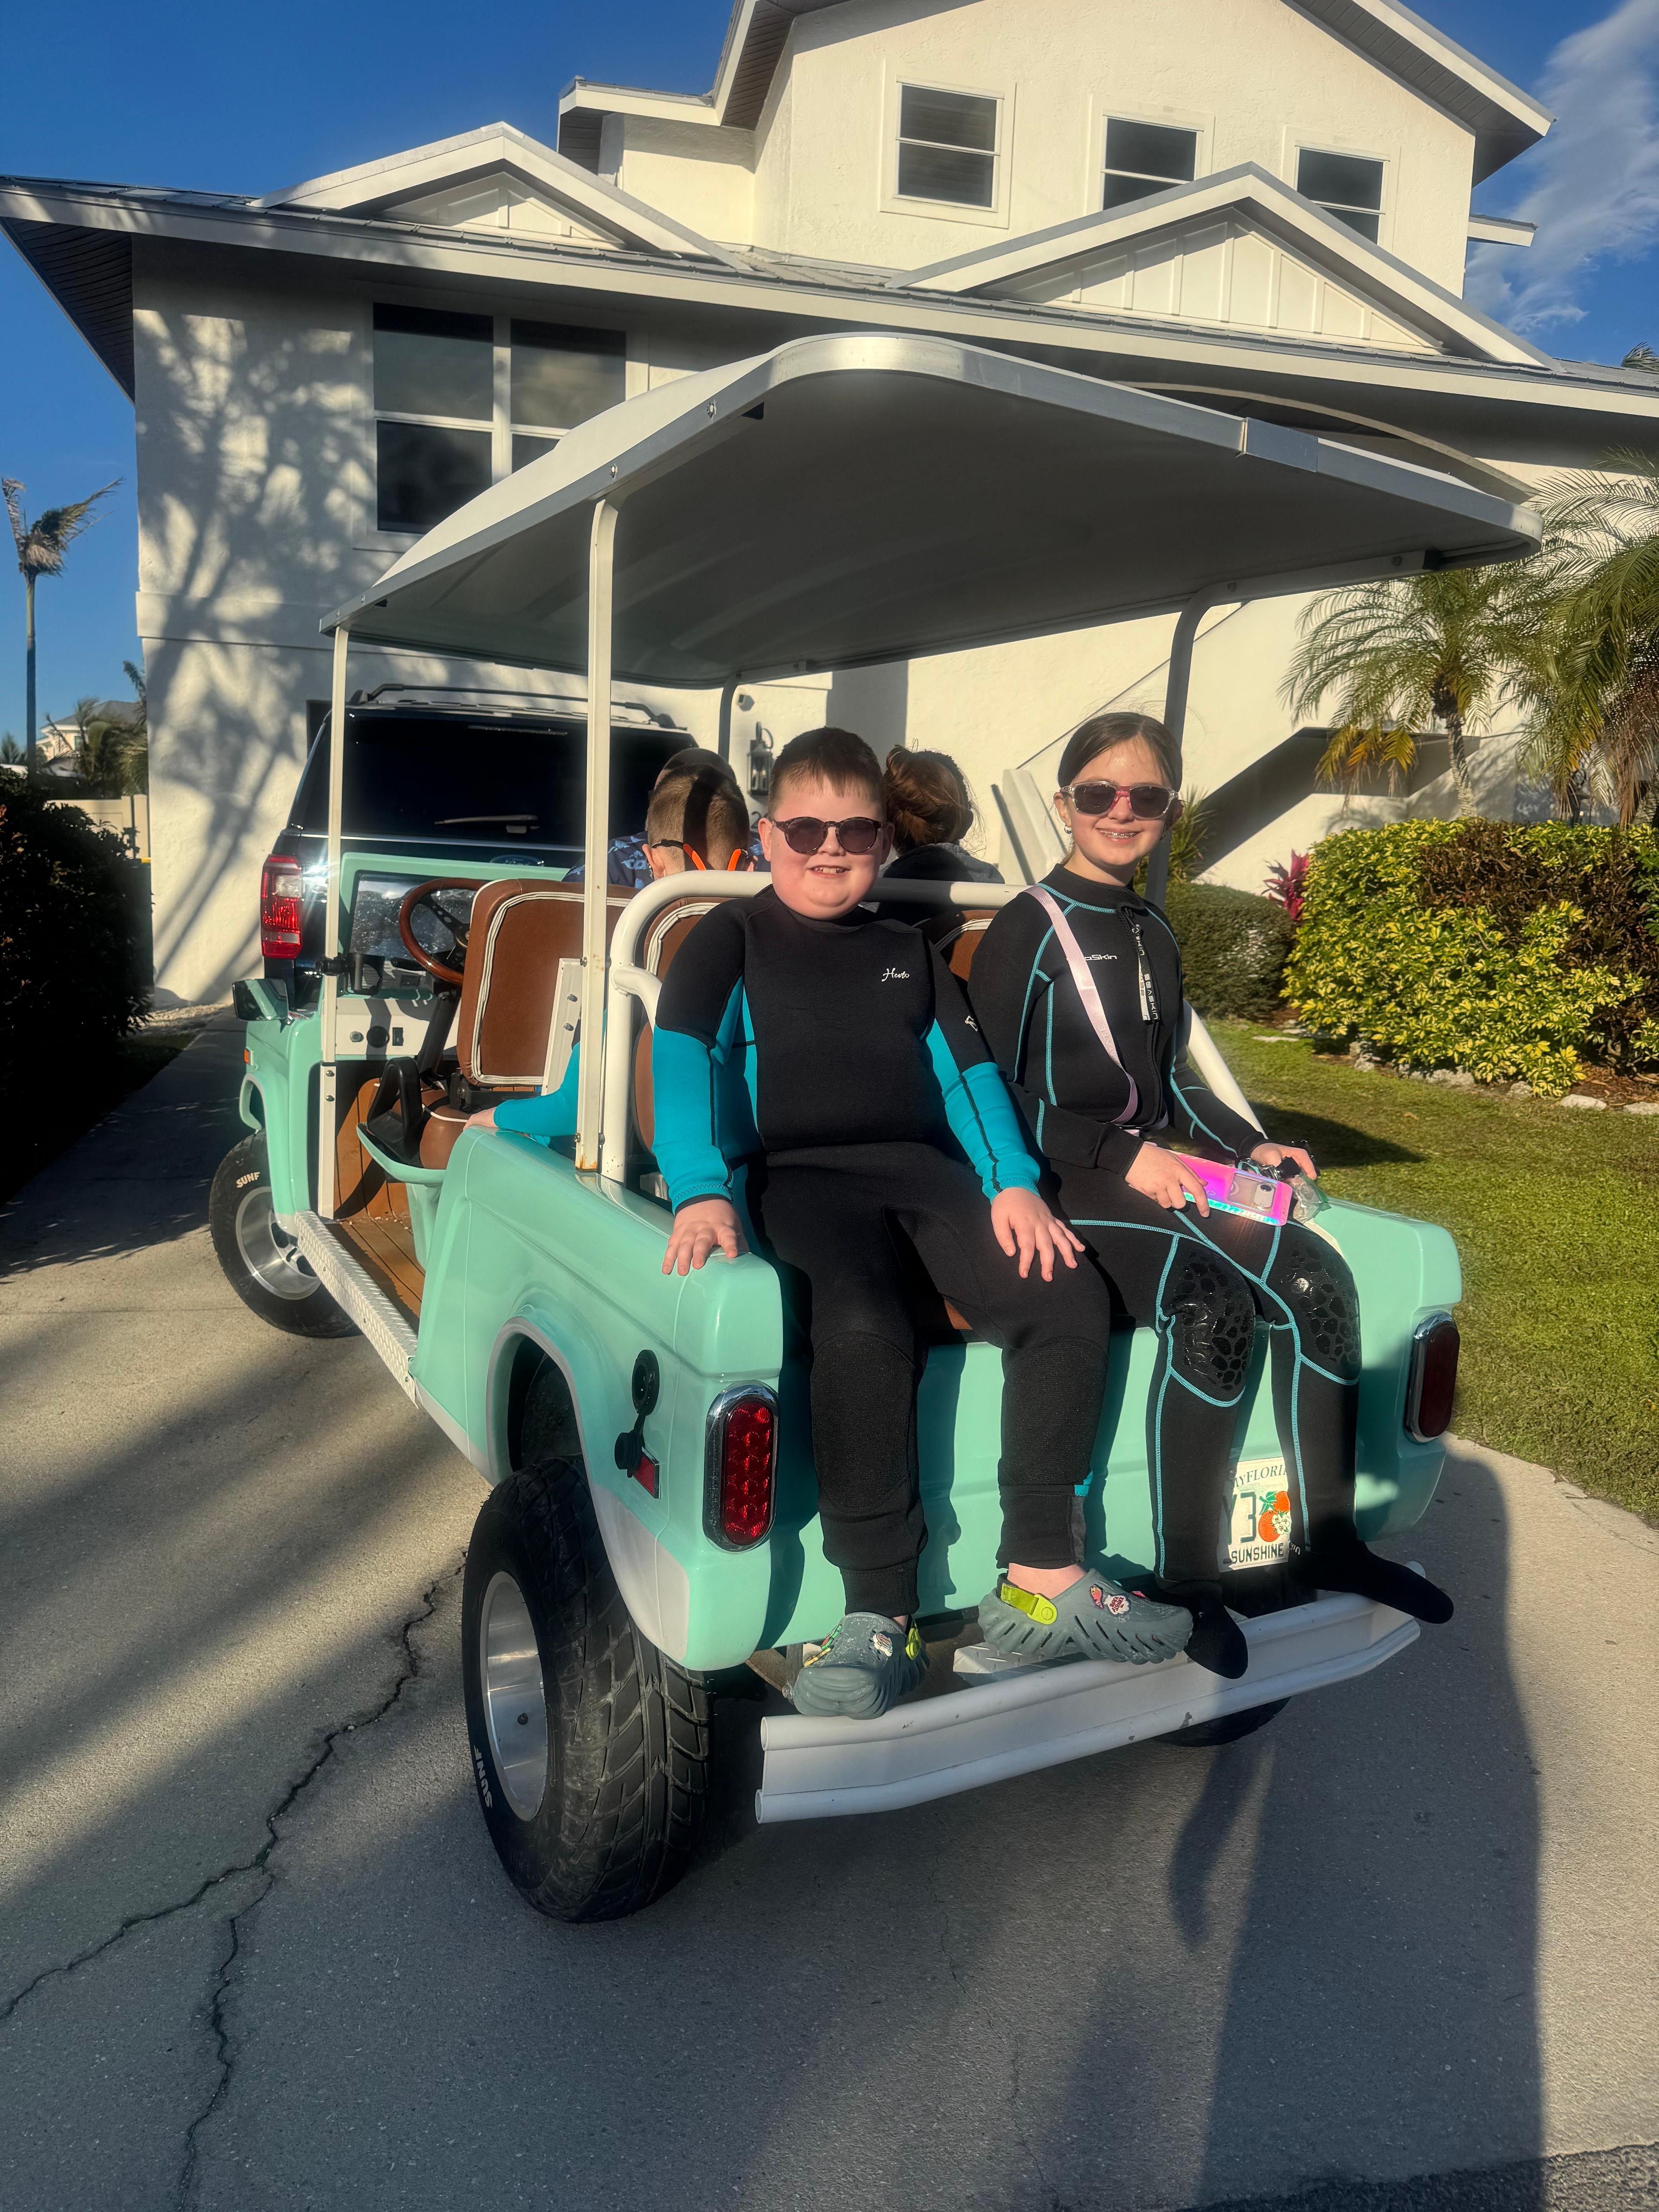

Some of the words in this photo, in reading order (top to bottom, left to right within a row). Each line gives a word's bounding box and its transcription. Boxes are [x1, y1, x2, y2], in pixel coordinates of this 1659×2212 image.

[236, 1172, 260, 1188] SUNF
[1231, 1542, 1283, 1564] SUNSHINE
[474, 1745, 493, 1809] SUNF
